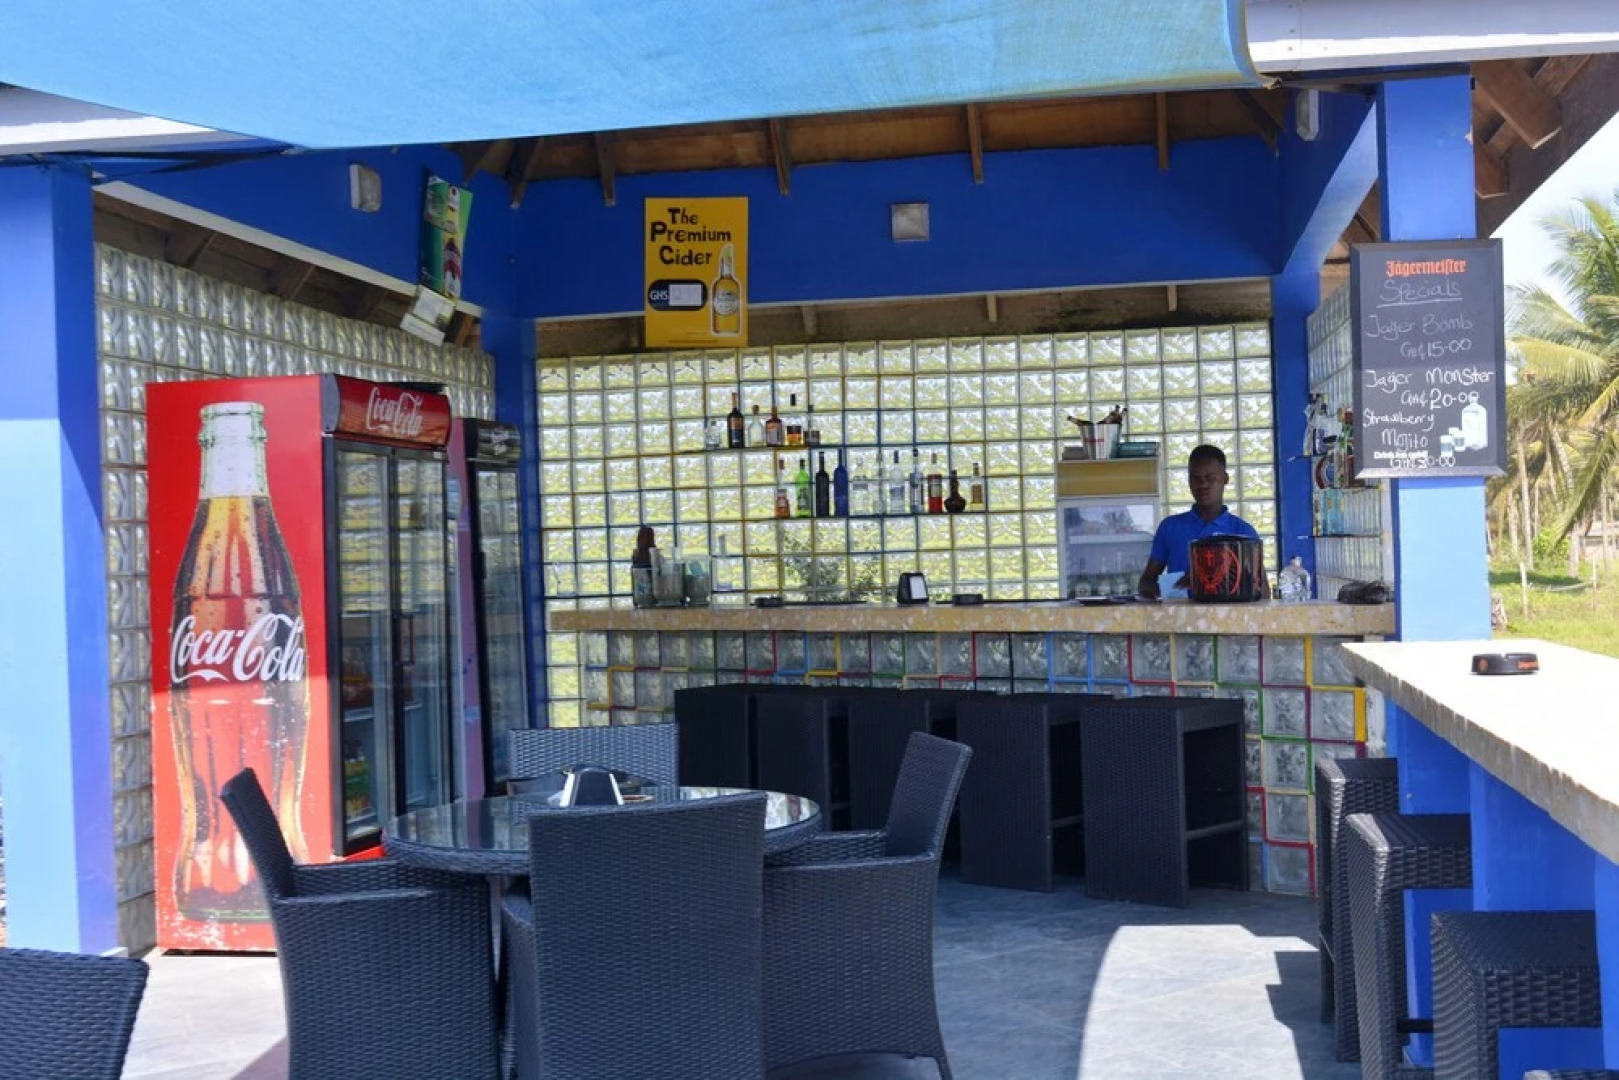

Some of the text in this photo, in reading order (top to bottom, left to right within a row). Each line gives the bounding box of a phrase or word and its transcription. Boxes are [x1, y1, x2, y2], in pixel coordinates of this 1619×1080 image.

[667, 207, 698, 225] The
[650, 221, 731, 242] Premium
[659, 245, 713, 265] Cider
[1380, 279, 1462, 304] Specials
[1422, 313, 1473, 336] Bomb
[366, 387, 424, 437] Coca-Cola
[170, 613, 305, 684] Coca-Cola
